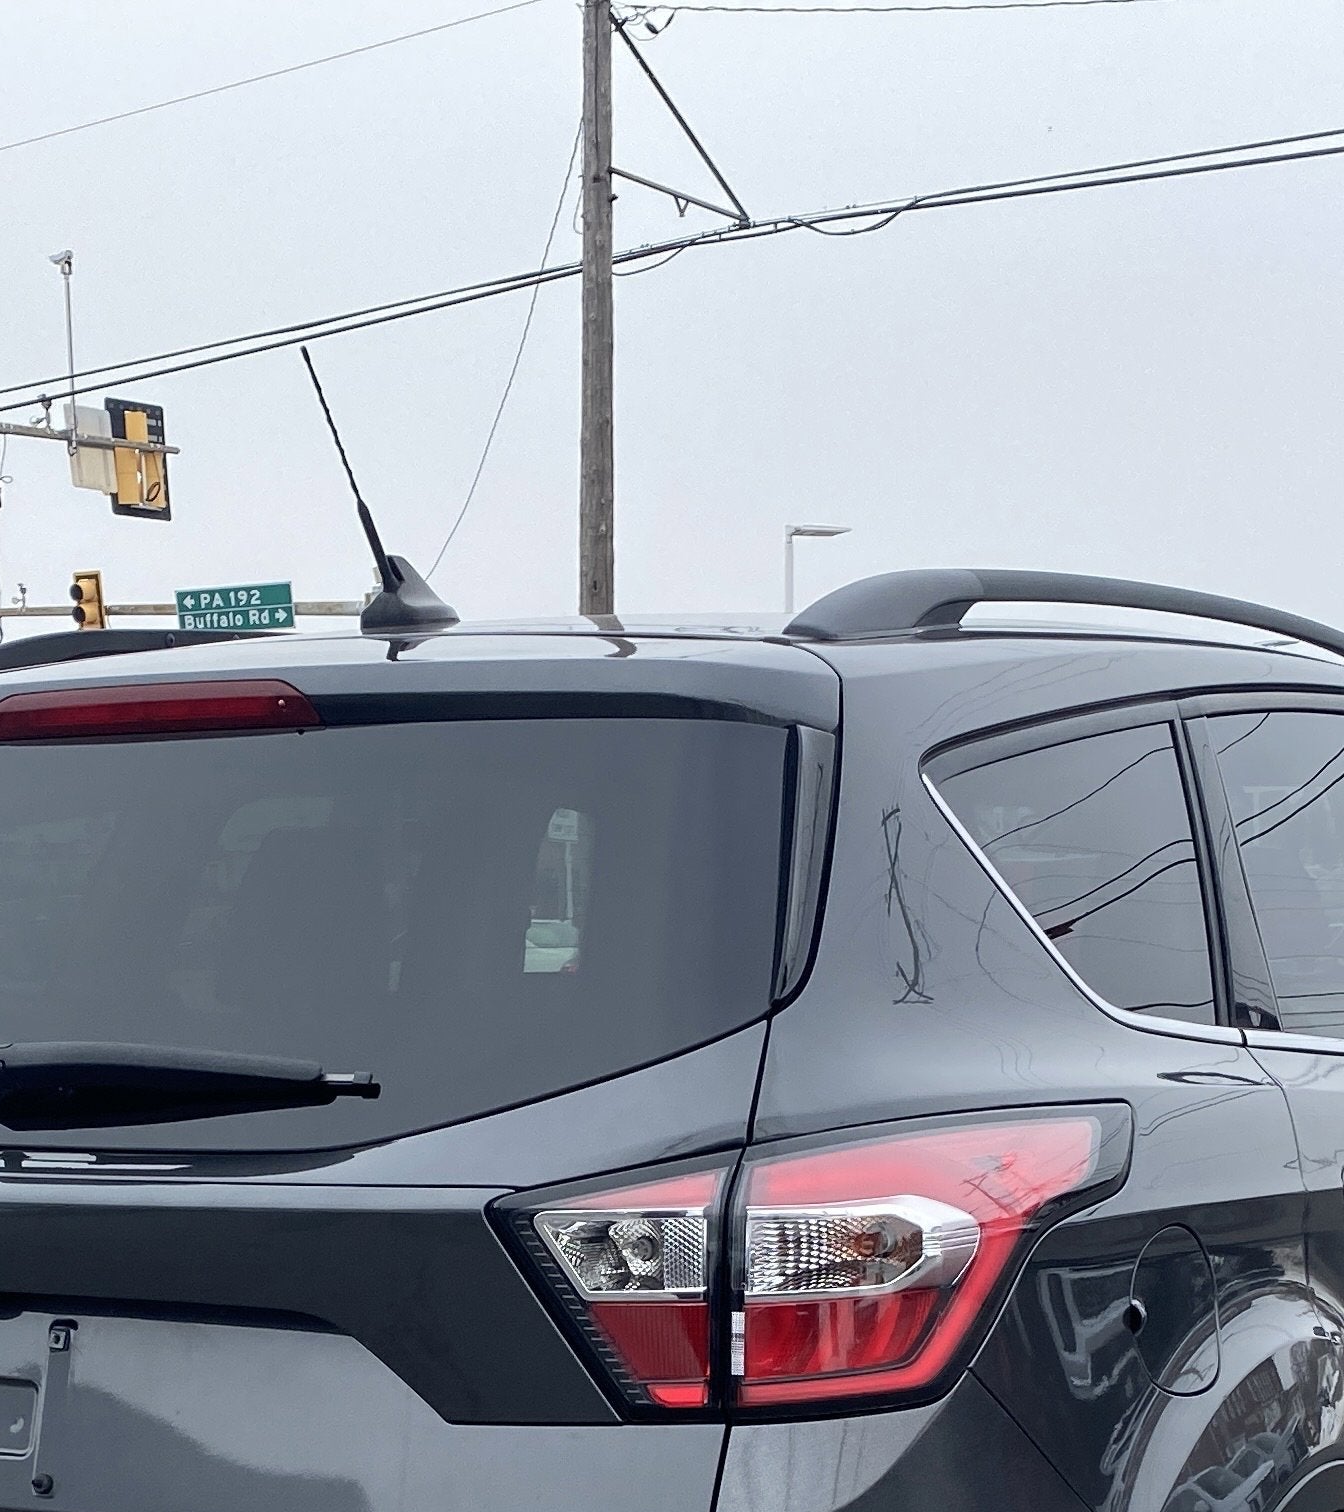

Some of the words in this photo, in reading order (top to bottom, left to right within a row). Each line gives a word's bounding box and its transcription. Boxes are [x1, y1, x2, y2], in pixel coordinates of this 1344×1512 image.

[199, 592, 225, 609] PA
[229, 589, 262, 607] 192
[184, 610, 244, 630] Buffalo
[248, 608, 271, 625] Rd
